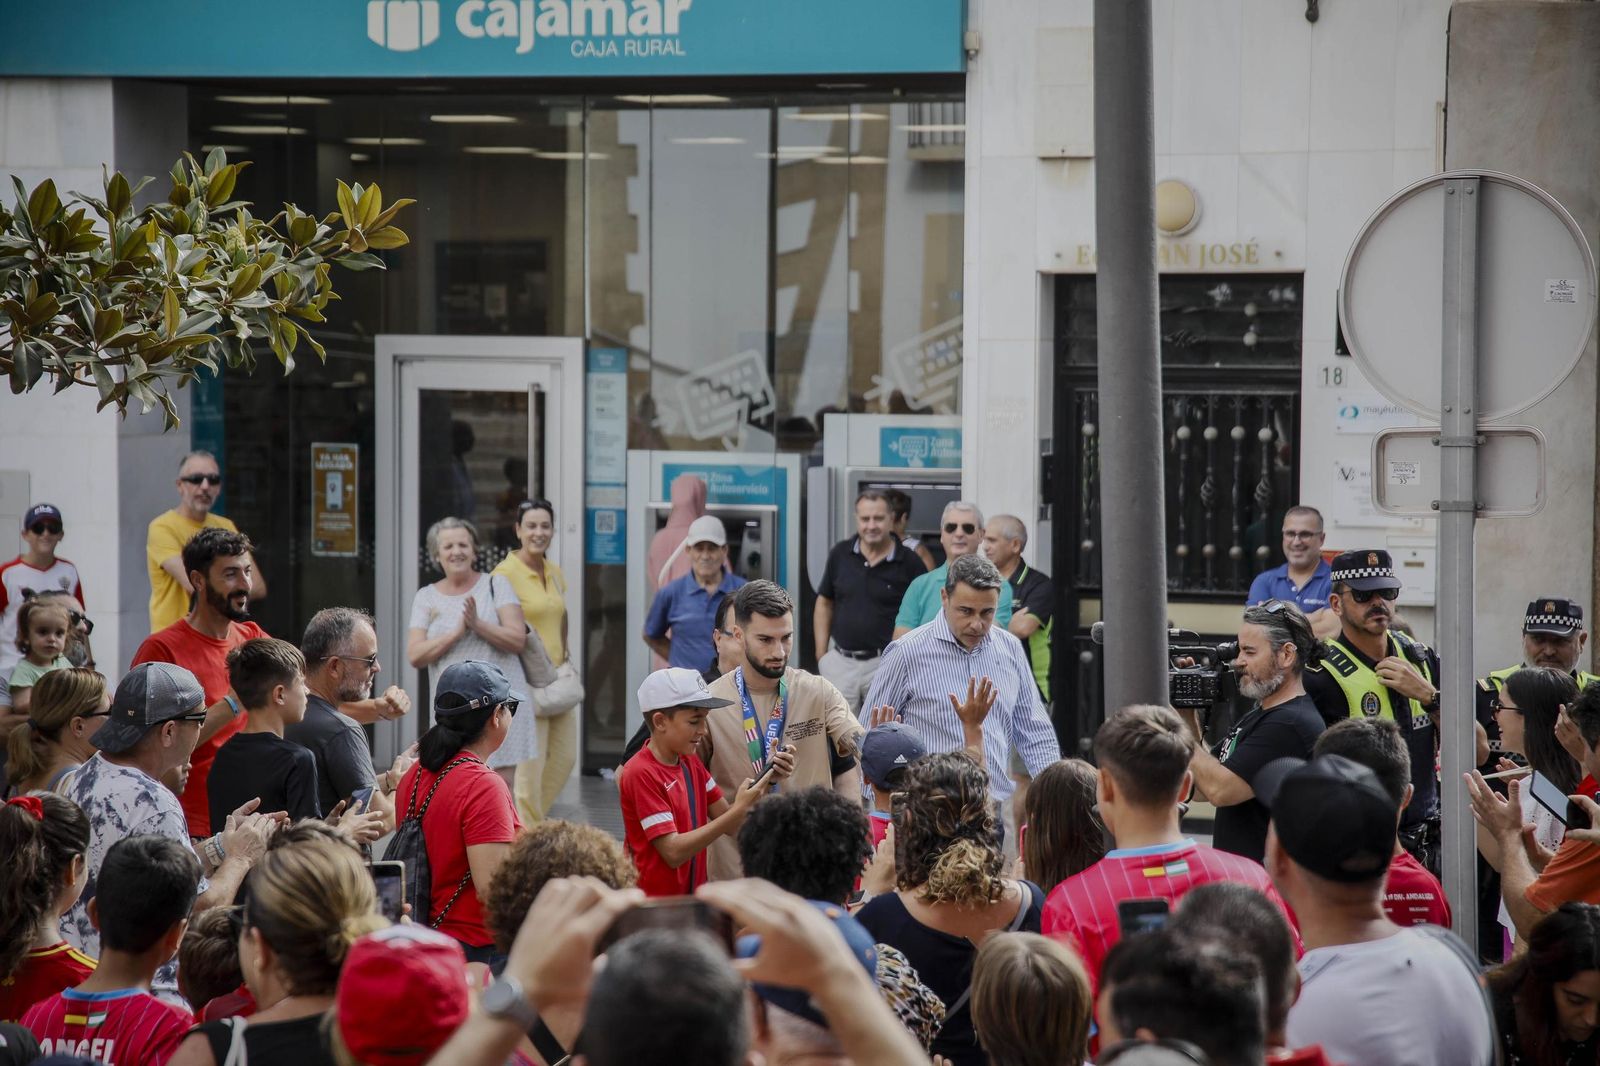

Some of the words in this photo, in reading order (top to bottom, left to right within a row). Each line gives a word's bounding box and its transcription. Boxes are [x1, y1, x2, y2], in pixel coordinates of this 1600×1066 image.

[456, 0, 693, 53] cajamar
[570, 40, 618, 56] CAJA
[624, 39, 686, 56] RURAL
[1158, 243, 1191, 265] AN
[1200, 237, 1259, 267] JOSÉ
[1322, 366, 1343, 386] 18
[710, 471, 733, 484] Zona
[710, 483, 769, 496] Autoservicio
